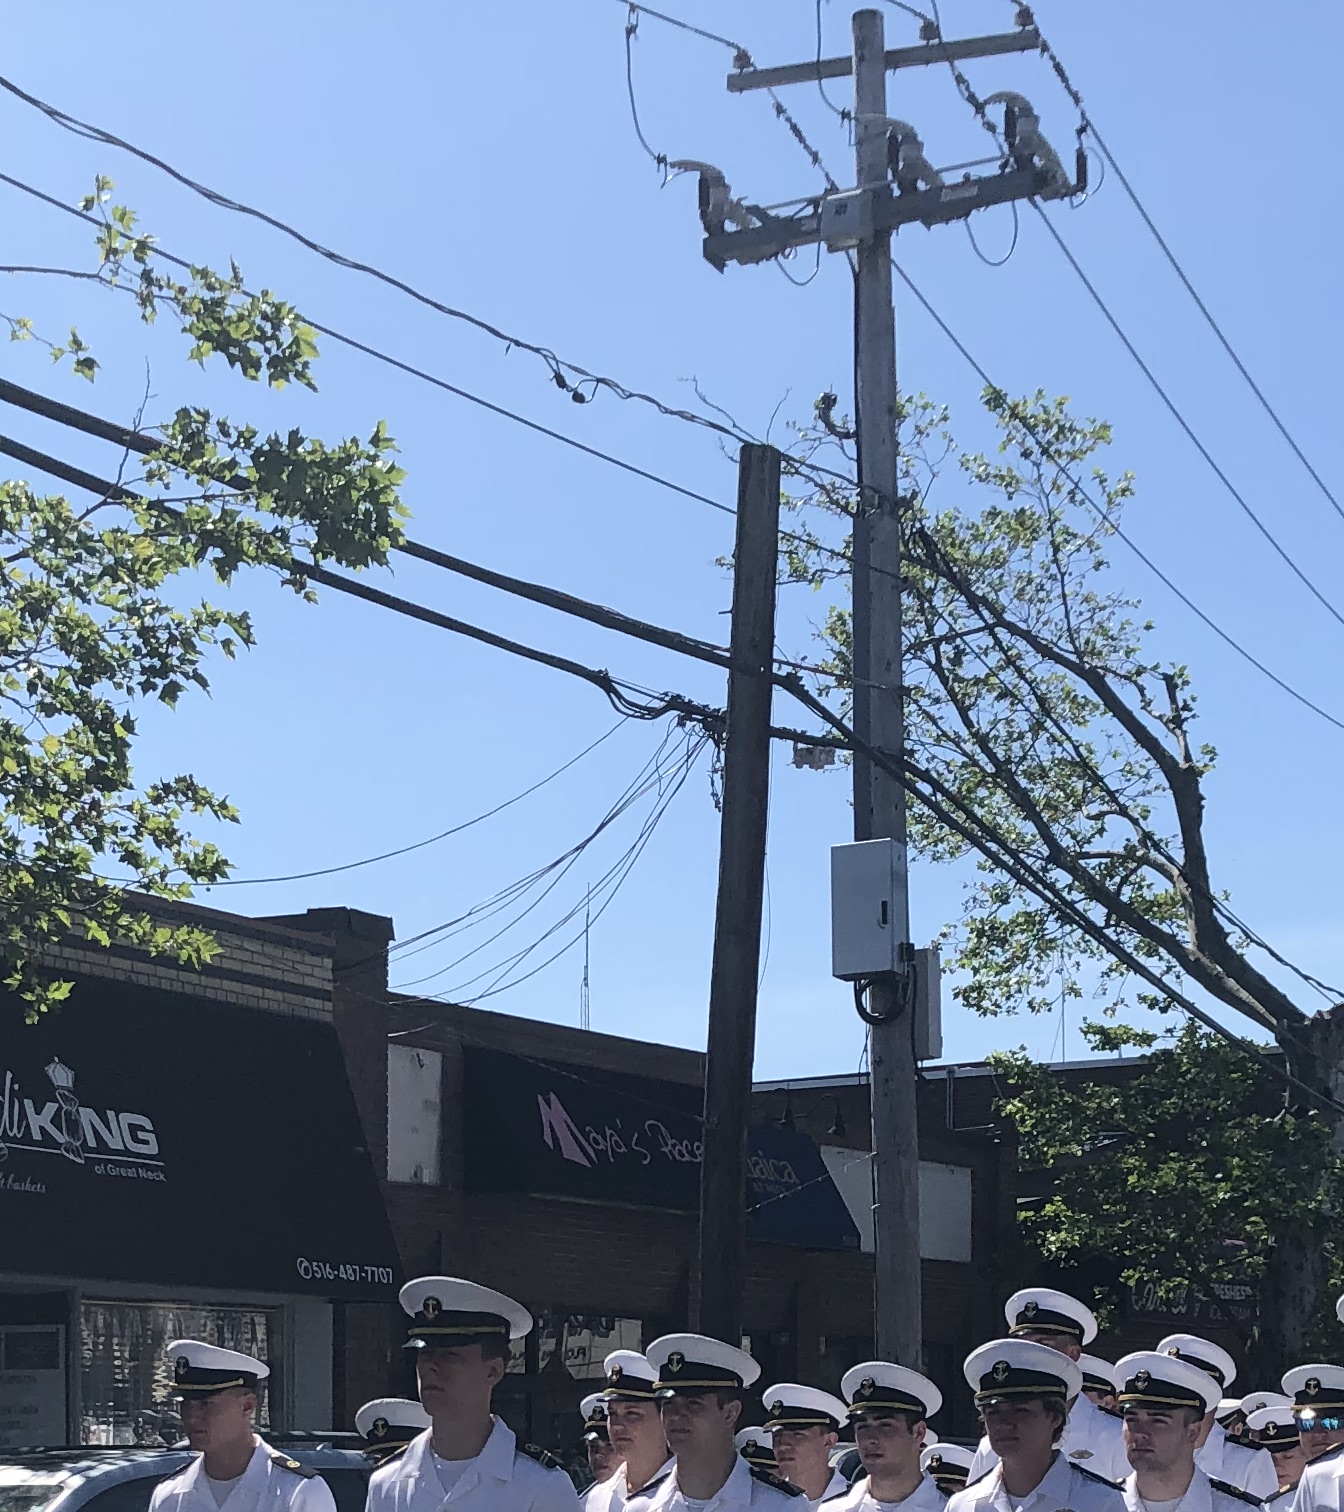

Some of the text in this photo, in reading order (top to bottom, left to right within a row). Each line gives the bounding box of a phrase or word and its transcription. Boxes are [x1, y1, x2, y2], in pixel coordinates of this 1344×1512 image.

[536, 1091, 704, 1168] Maya's Place
[6, 1173, 47, 1194] baskets
[94, 1163, 167, 1182] of Great Neck
[312, 1261, 393, 1284] 516-487-7707
